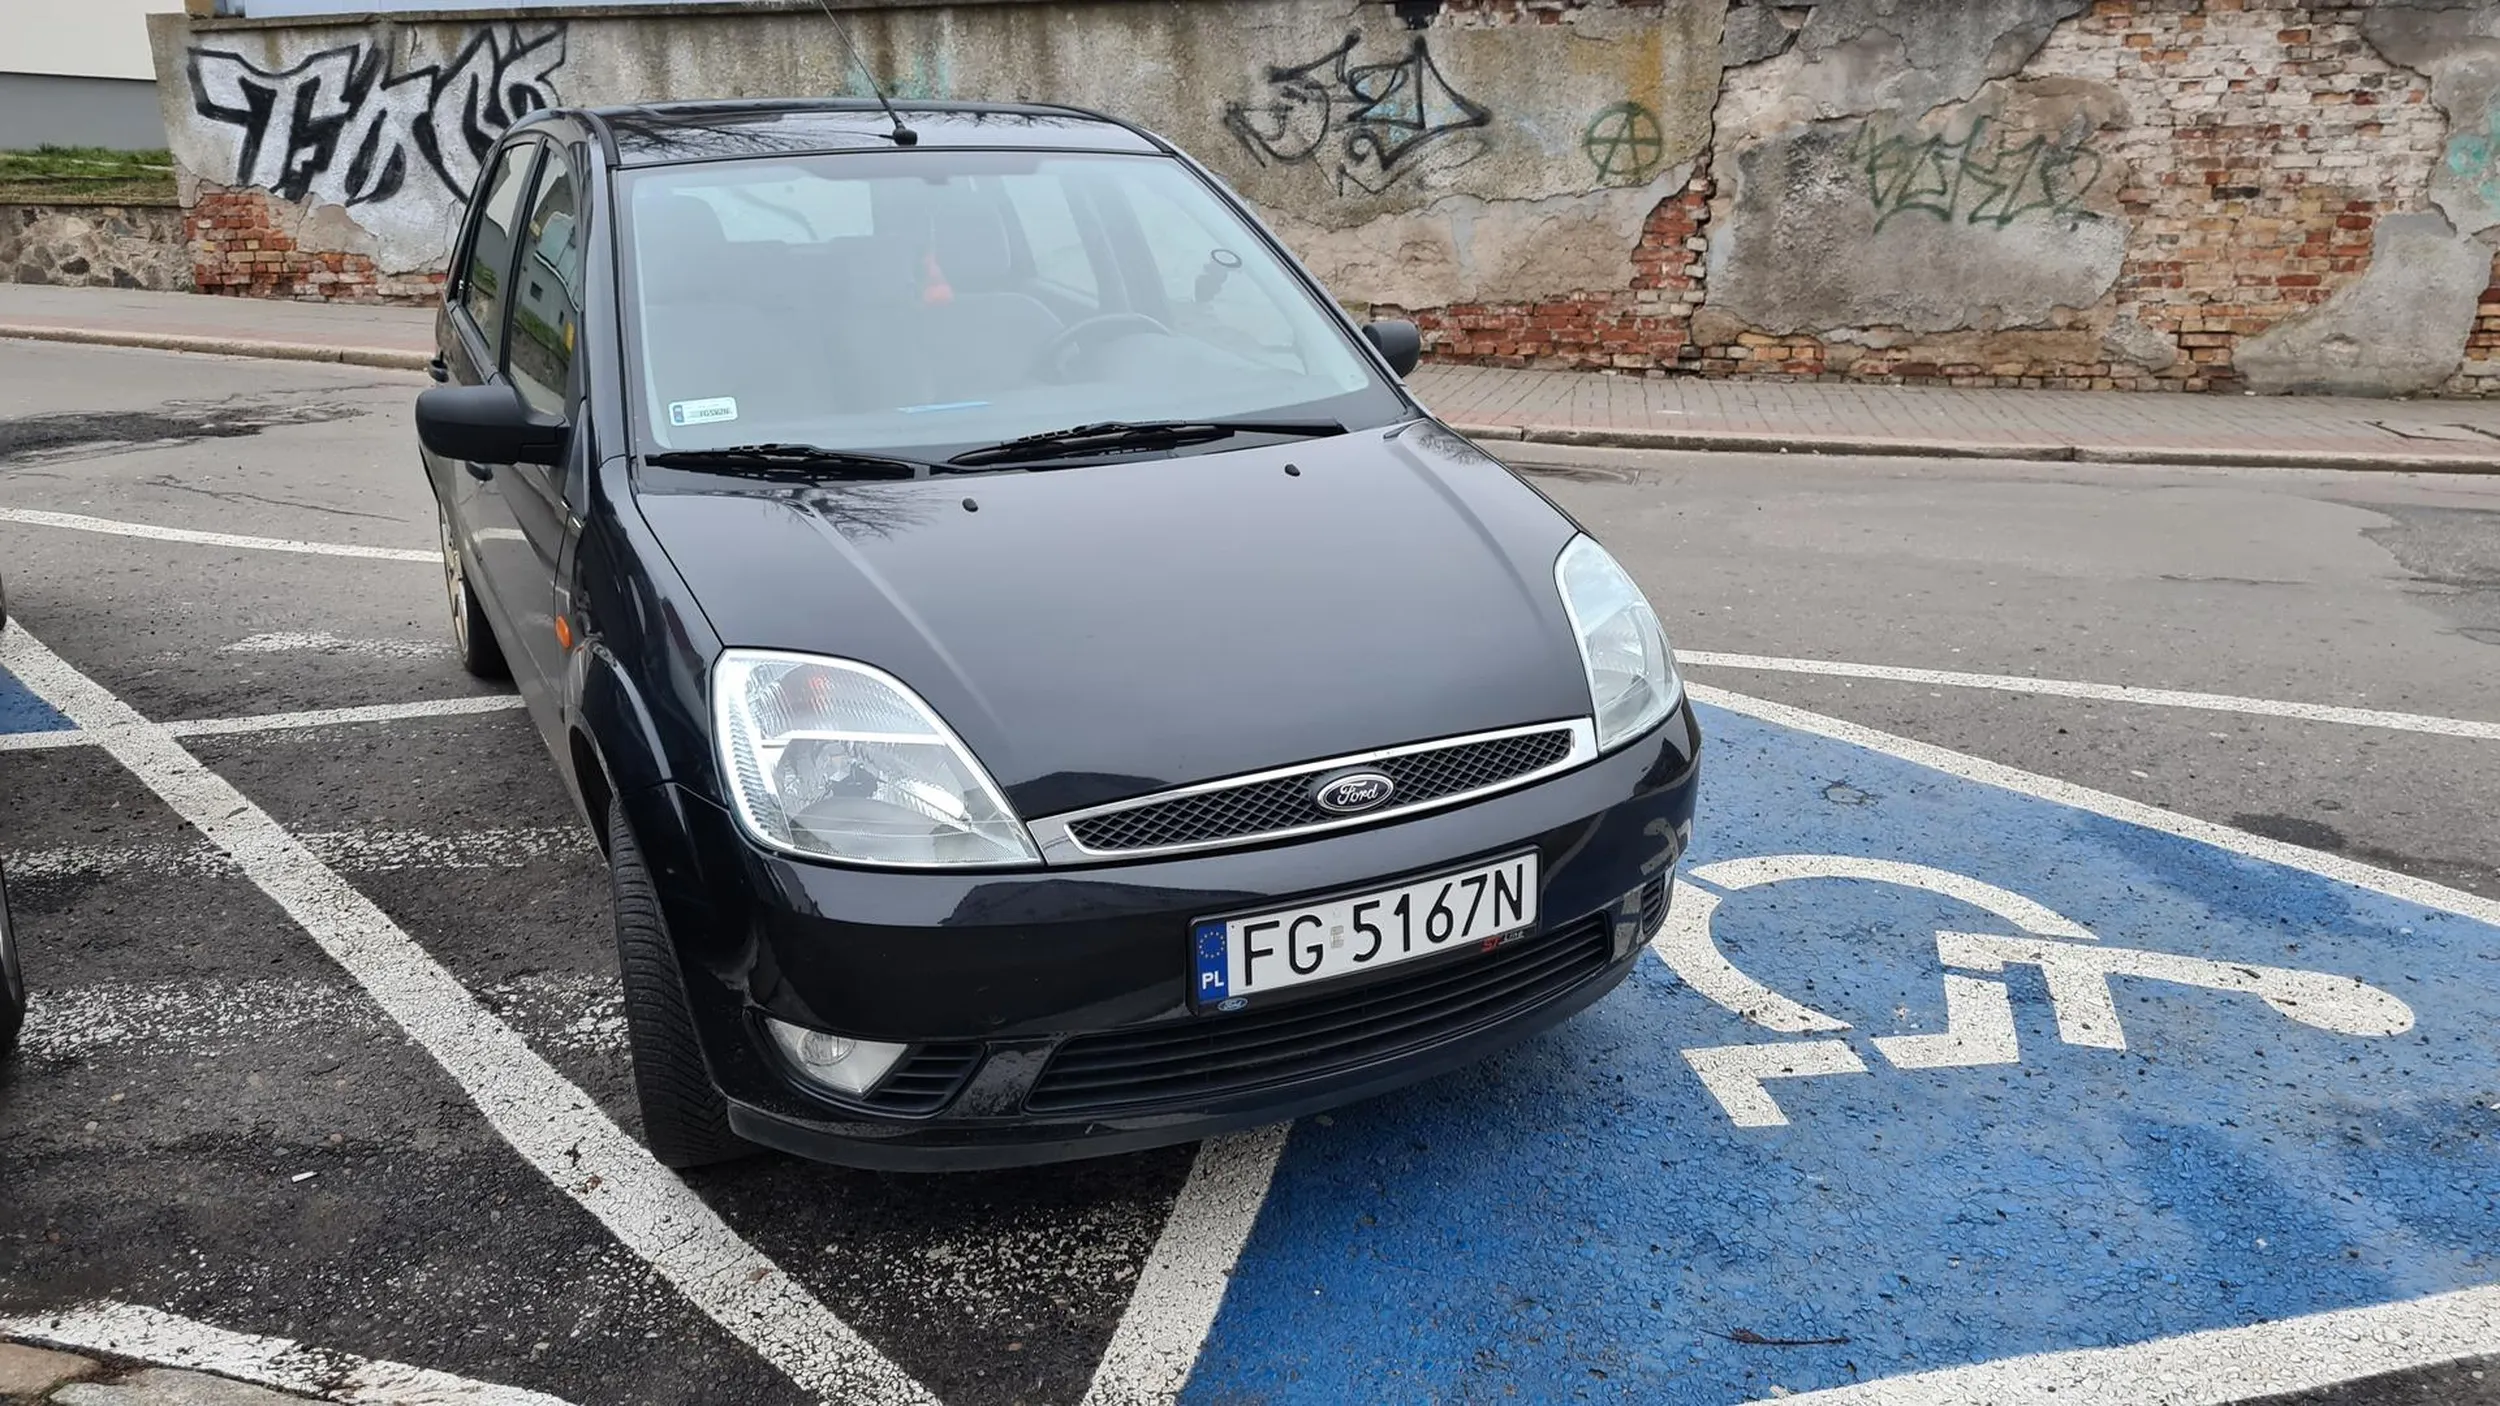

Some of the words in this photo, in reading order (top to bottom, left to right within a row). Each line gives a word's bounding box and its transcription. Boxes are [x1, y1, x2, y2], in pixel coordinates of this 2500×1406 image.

[1337, 780, 1379, 805] Ford
[1244, 914, 1323, 987] FG
[1353, 864, 1524, 963] 5167N
[1202, 970, 1224, 990] PL
